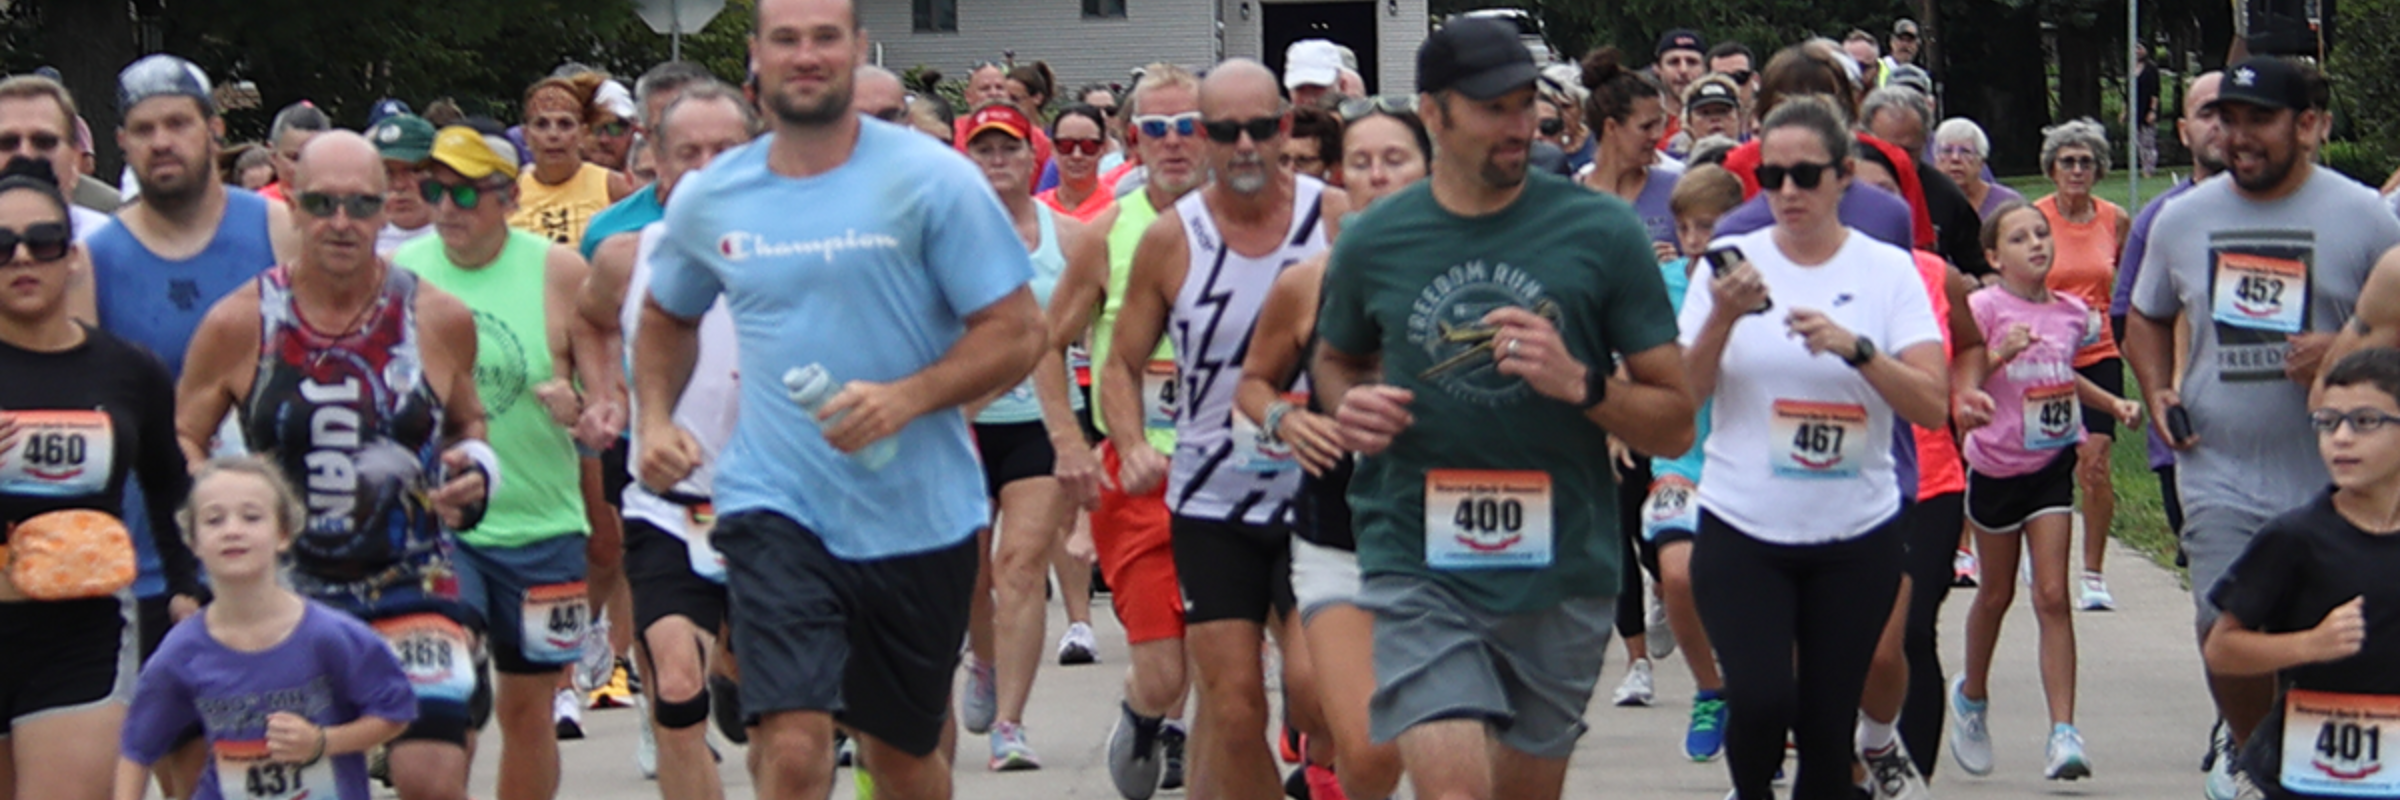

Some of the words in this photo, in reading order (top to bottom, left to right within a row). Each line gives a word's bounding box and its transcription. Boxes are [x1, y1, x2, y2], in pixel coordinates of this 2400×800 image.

[718, 229, 898, 262] Champion
[1407, 259, 1485, 343] FREEDOM
[1492, 261, 1543, 298] RUN
[2235, 275, 2285, 305] 452
[2040, 399, 2072, 426] 429
[22, 433, 86, 466] 460
[298, 375, 361, 532] JUAN
[1794, 423, 1845, 455] 467
[1454, 498, 1522, 534] 400
[2315, 721, 2379, 761] 401
